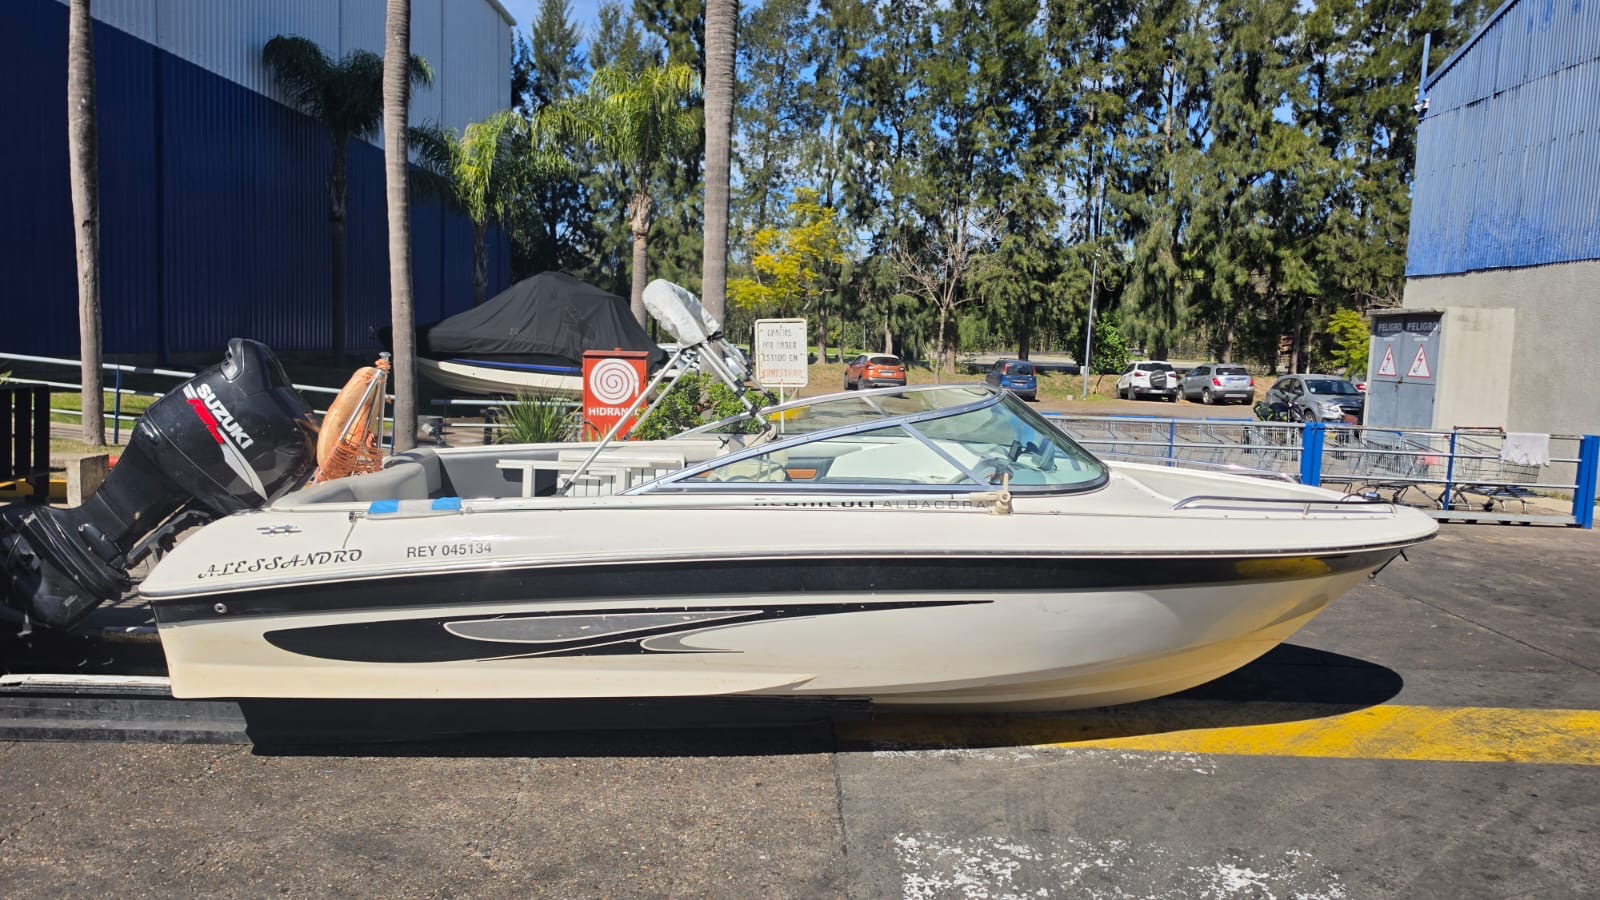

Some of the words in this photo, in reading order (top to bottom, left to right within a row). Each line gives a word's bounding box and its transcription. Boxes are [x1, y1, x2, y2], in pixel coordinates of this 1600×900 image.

[1378, 322, 1402, 332] PELIGRO
[1407, 322, 1439, 331] PELIGRO
[196, 383, 254, 450] SUZUKI
[588, 407, 640, 416] HIDRAN
[882, 500, 987, 509] ALBACORA
[407, 546, 437, 558] REY
[442, 543, 492, 556] 045134
[198, 549, 363, 579] ALESSANDRO
